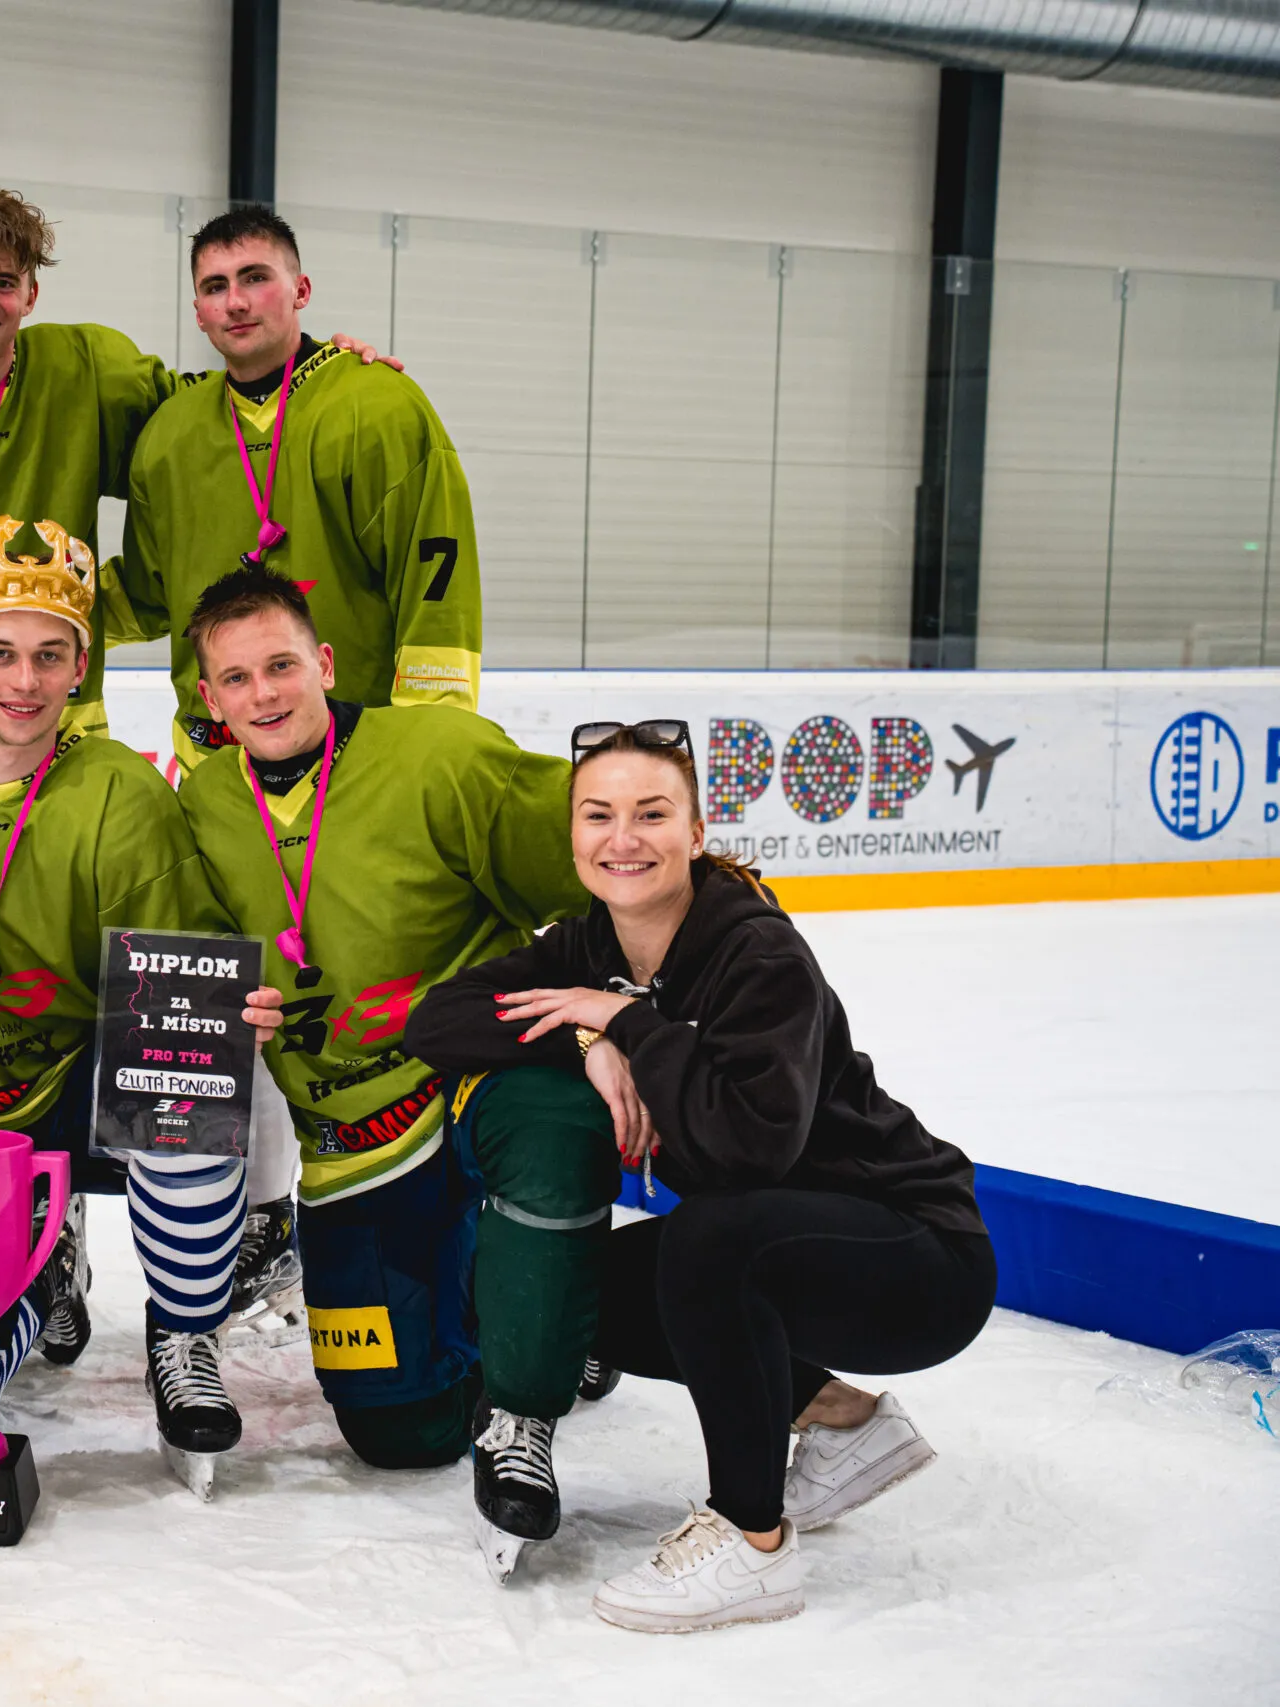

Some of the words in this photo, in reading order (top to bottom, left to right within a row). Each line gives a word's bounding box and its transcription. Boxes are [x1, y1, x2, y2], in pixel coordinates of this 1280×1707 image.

[419, 537, 459, 601] 7
[707, 715, 933, 824] POP
[796, 835, 811, 859] &
[129, 951, 239, 979] DIPLOM
[170, 997, 192, 1010] ZA
[140, 1014, 155, 1029] 1.
[161, 1013, 227, 1035] MÍSTO
[142, 1048, 173, 1062] PRO
[179, 1049, 213, 1065] TÝM
[119, 1069, 164, 1092] ŽLUTÁ
[168, 1076, 235, 1097] PONORKA
[157, 1118, 189, 1126] HOCKEY
[155, 1136, 188, 1144] CCM
[309, 1328, 381, 1347] RTUNA
